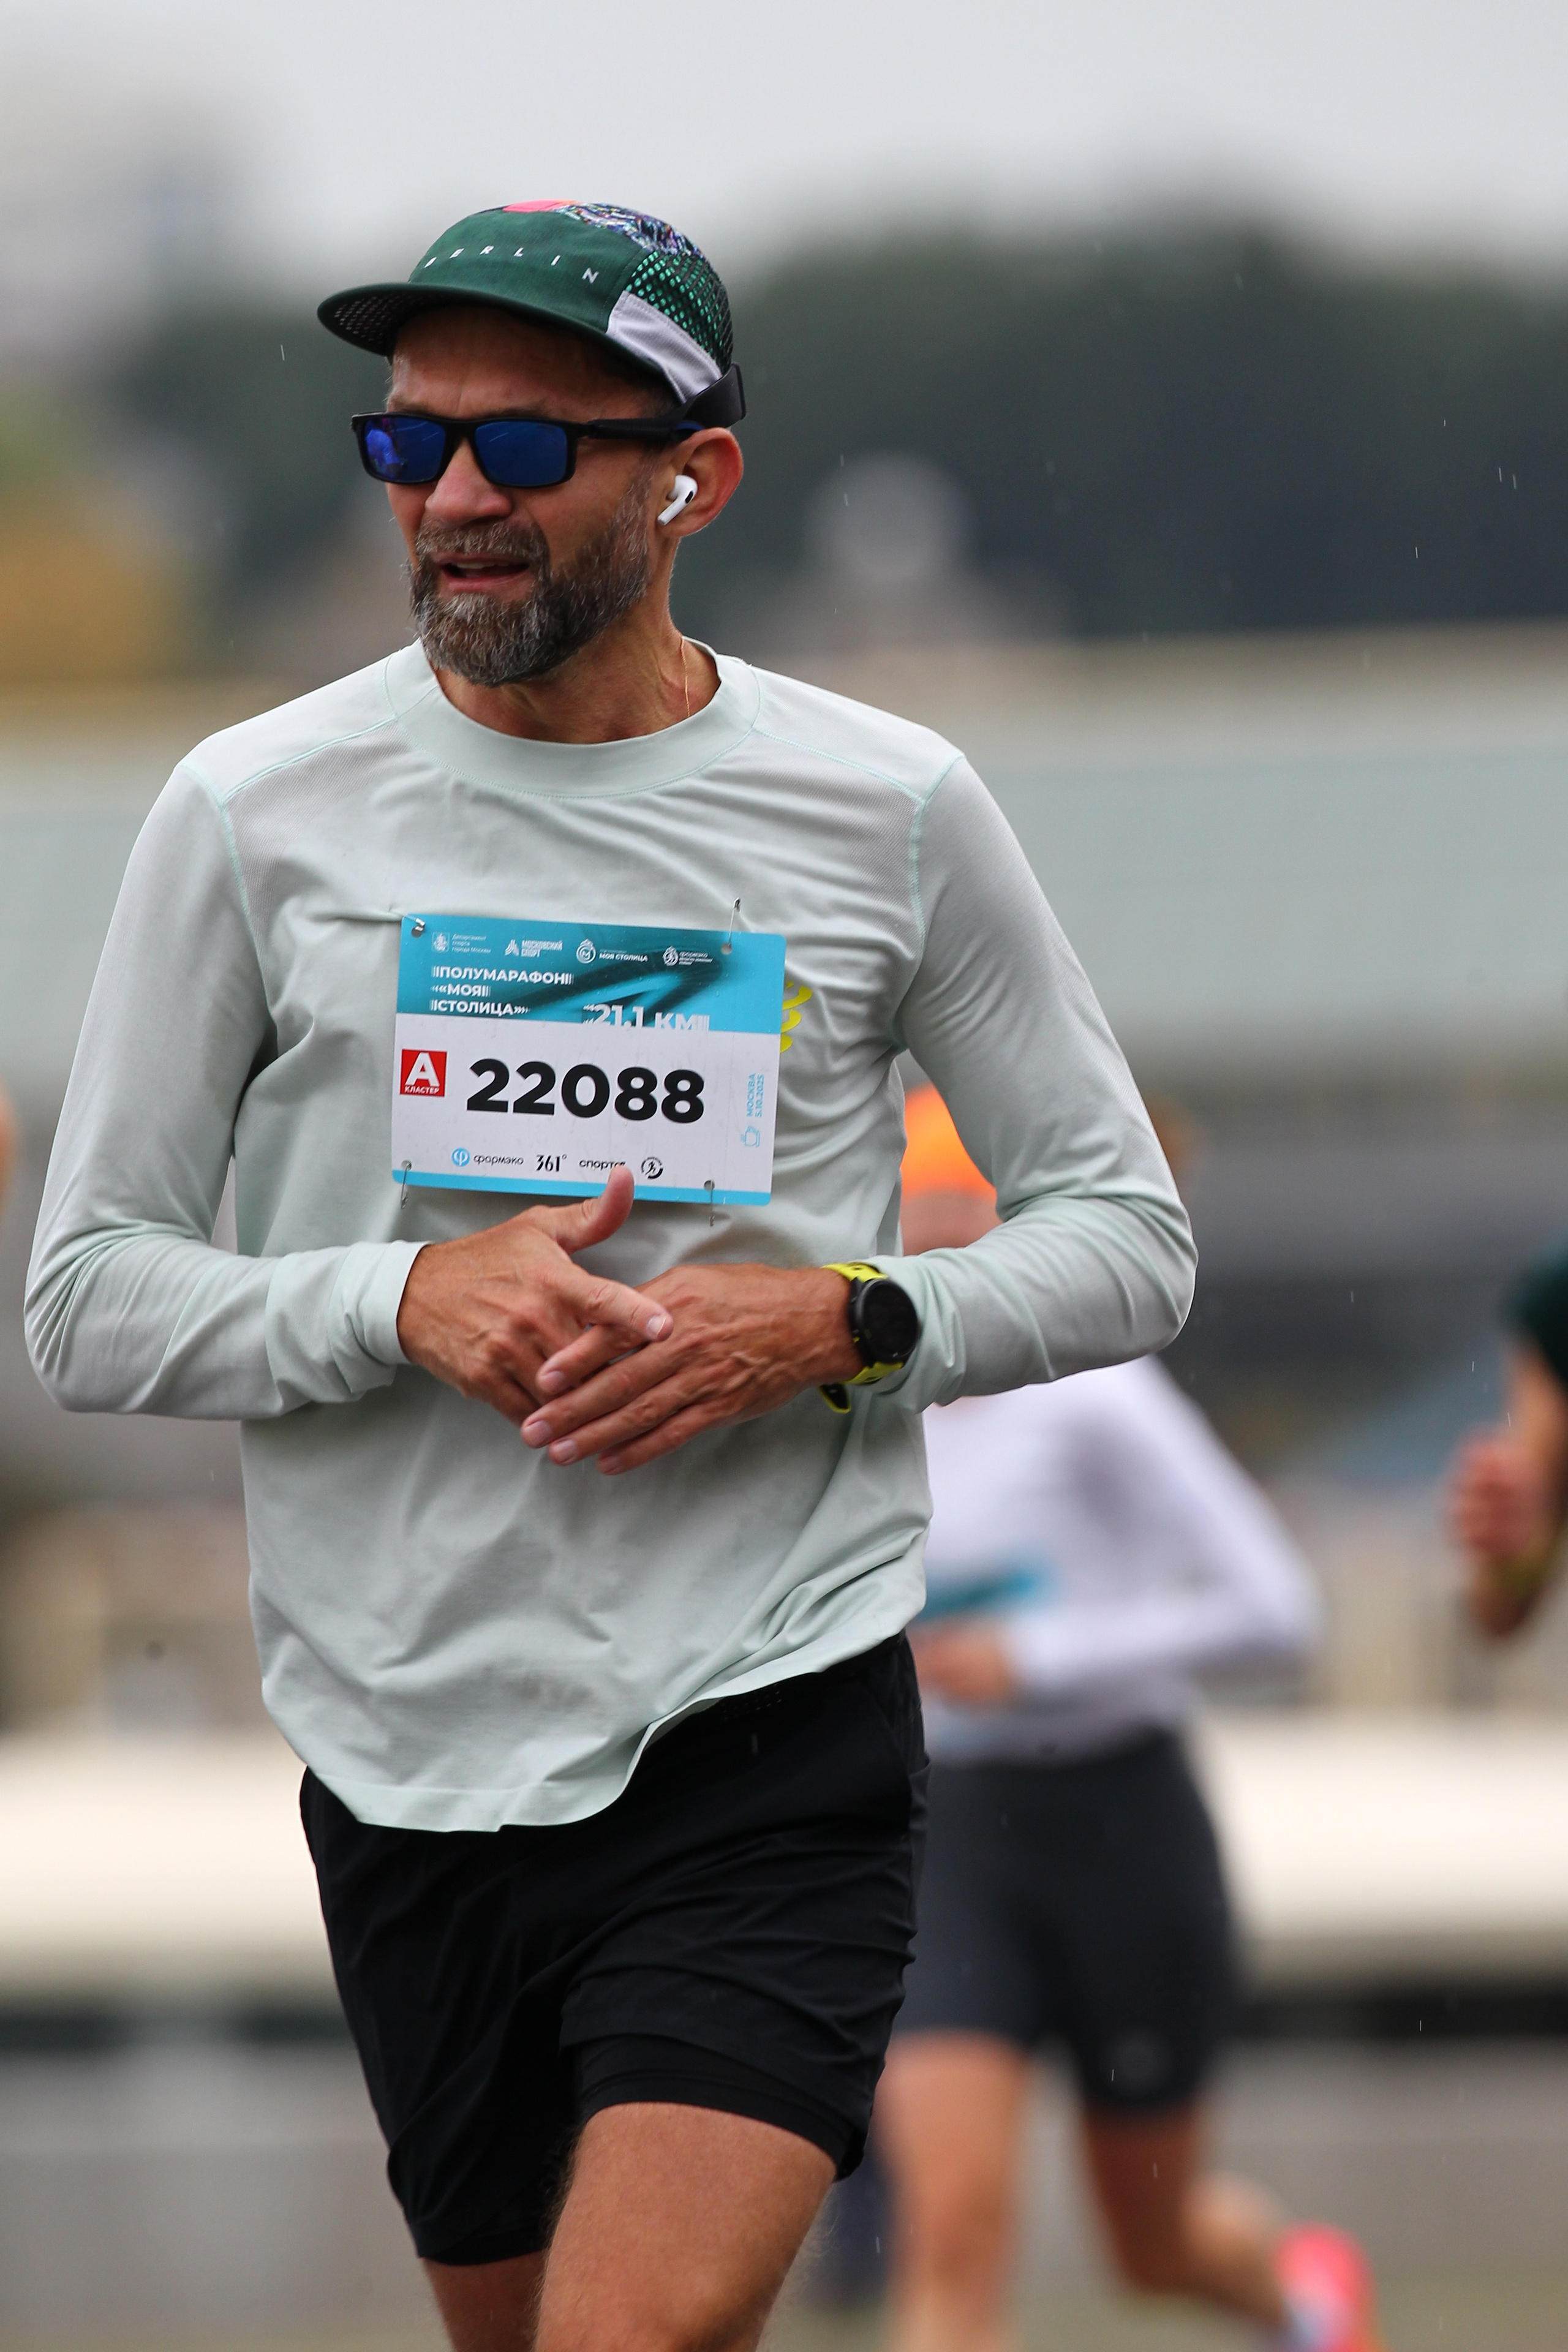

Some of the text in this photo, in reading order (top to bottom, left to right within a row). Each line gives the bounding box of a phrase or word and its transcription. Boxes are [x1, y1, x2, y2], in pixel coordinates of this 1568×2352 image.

[615, 954, 648, 962] СТОЛИЦА
[439, 965, 567, 986] ПОЛУМАРАФОН
[591, 1003, 644, 1027] 21.1
[405, 1052, 440, 1086] А
[404, 1086, 440, 1095] КЛАСТЕР
[466, 1058, 705, 1123] 22088
[747, 1073, 756, 1117] МОСКВА
